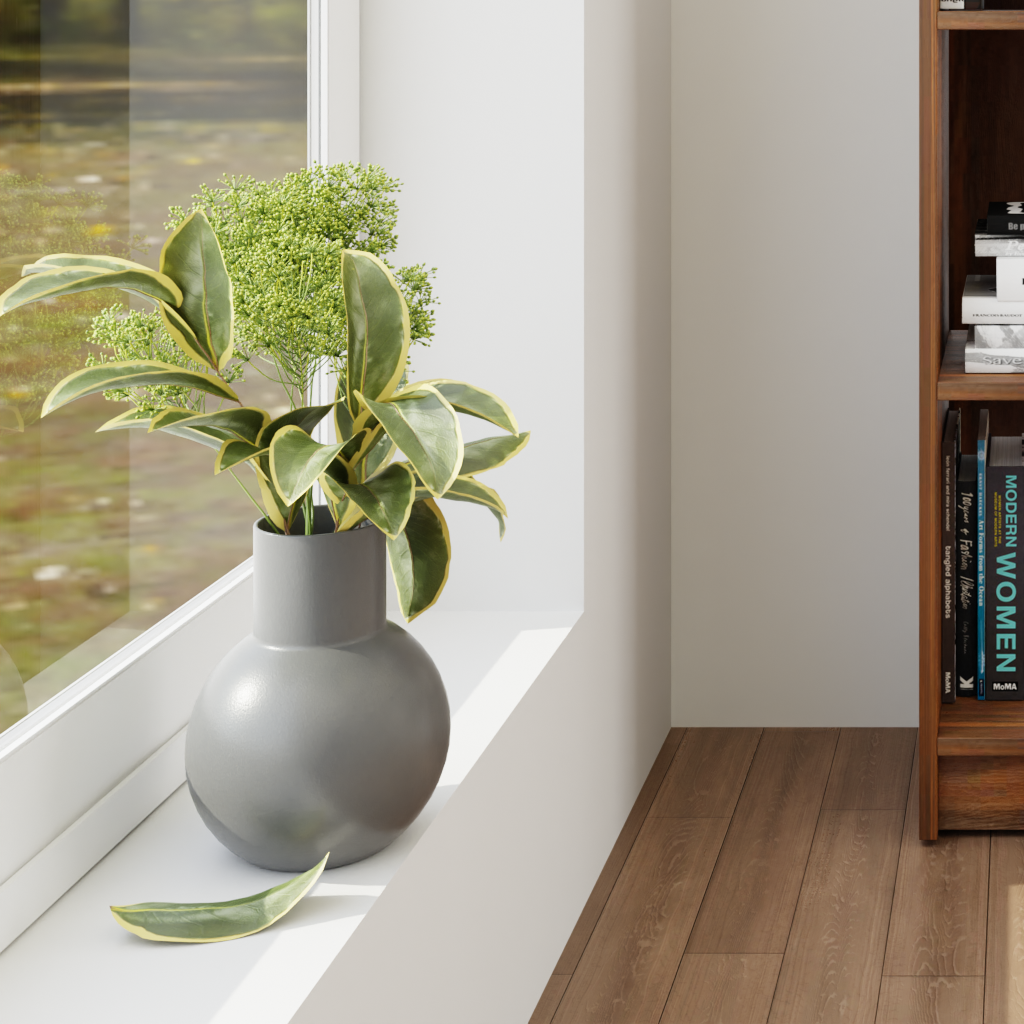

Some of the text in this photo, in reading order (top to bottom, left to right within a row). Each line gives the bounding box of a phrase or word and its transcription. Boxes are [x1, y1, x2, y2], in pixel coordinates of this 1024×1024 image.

[1008, 222, 1018, 230] Be
[982, 355, 1023, 366] Save
[1005, 475, 1017, 547] MODERN
[959, 539, 973, 570] Fashion
[943, 545, 952, 619] tangled alphabets
[996, 552, 1017, 673] WOMEN
[992, 682, 1018, 691] MoMA
